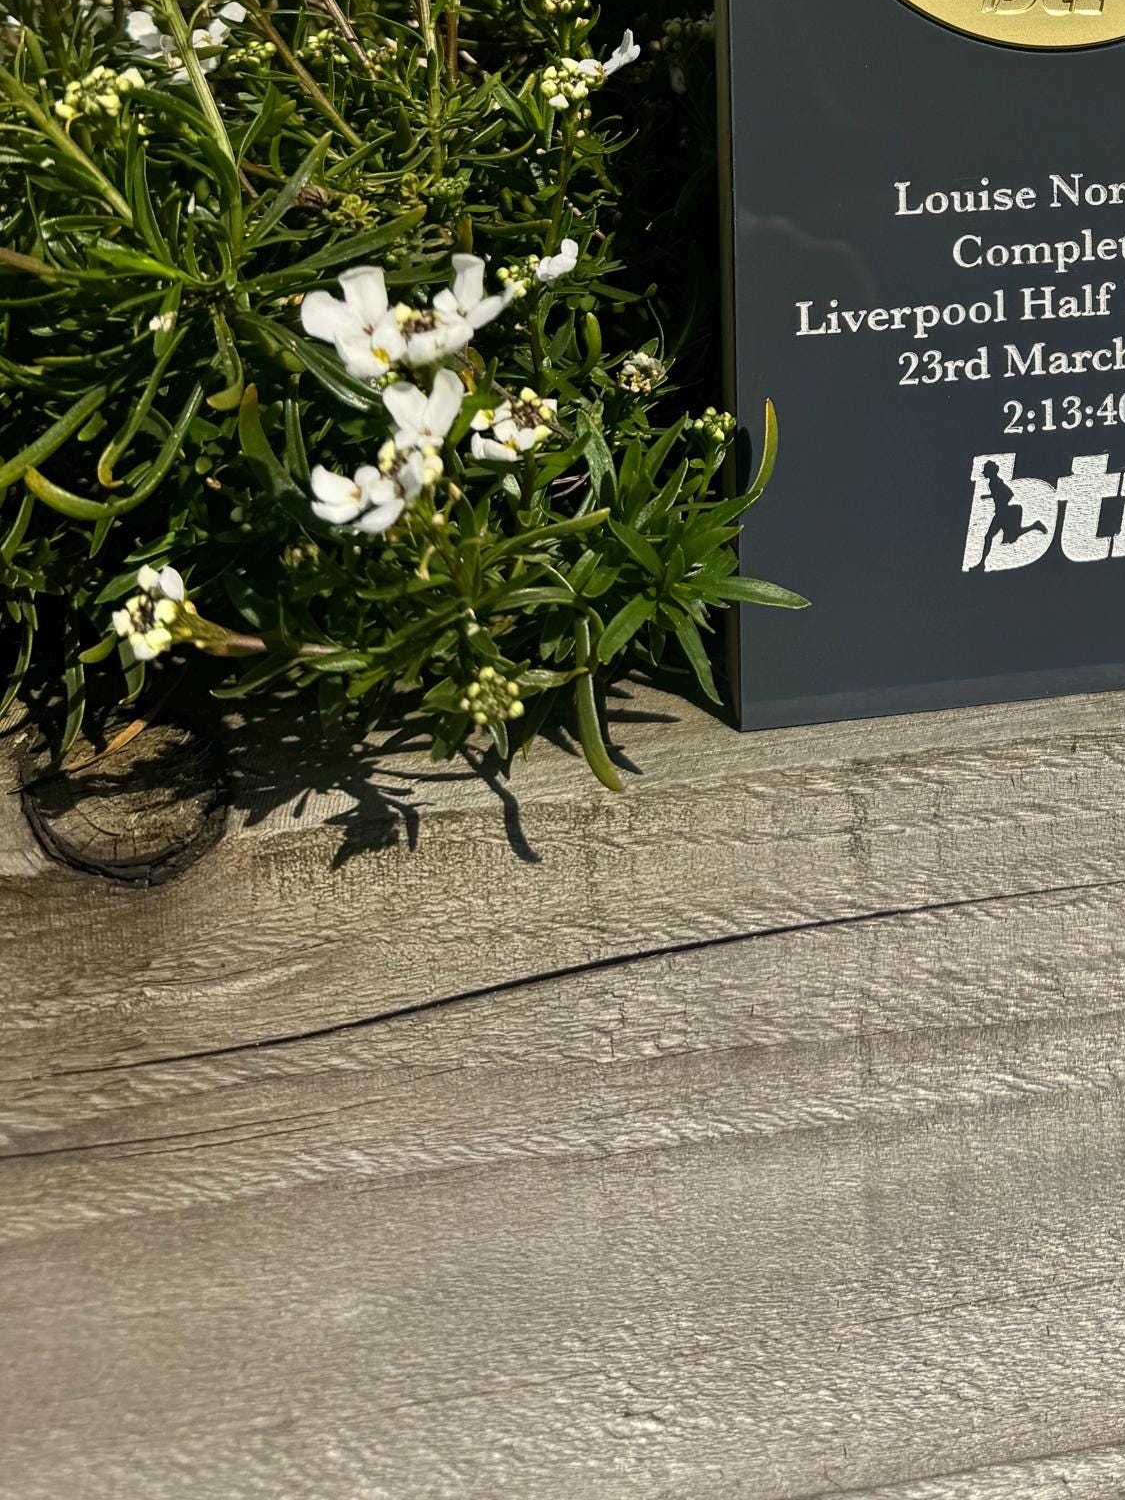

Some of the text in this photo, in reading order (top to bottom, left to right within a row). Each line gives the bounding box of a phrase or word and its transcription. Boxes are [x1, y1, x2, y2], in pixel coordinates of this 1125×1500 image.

[894, 177, 1036, 216] Louise
[795, 289, 1008, 339] Liverpool
[1020, 281, 1115, 321] Half
[898, 346, 991, 386] 23rd
